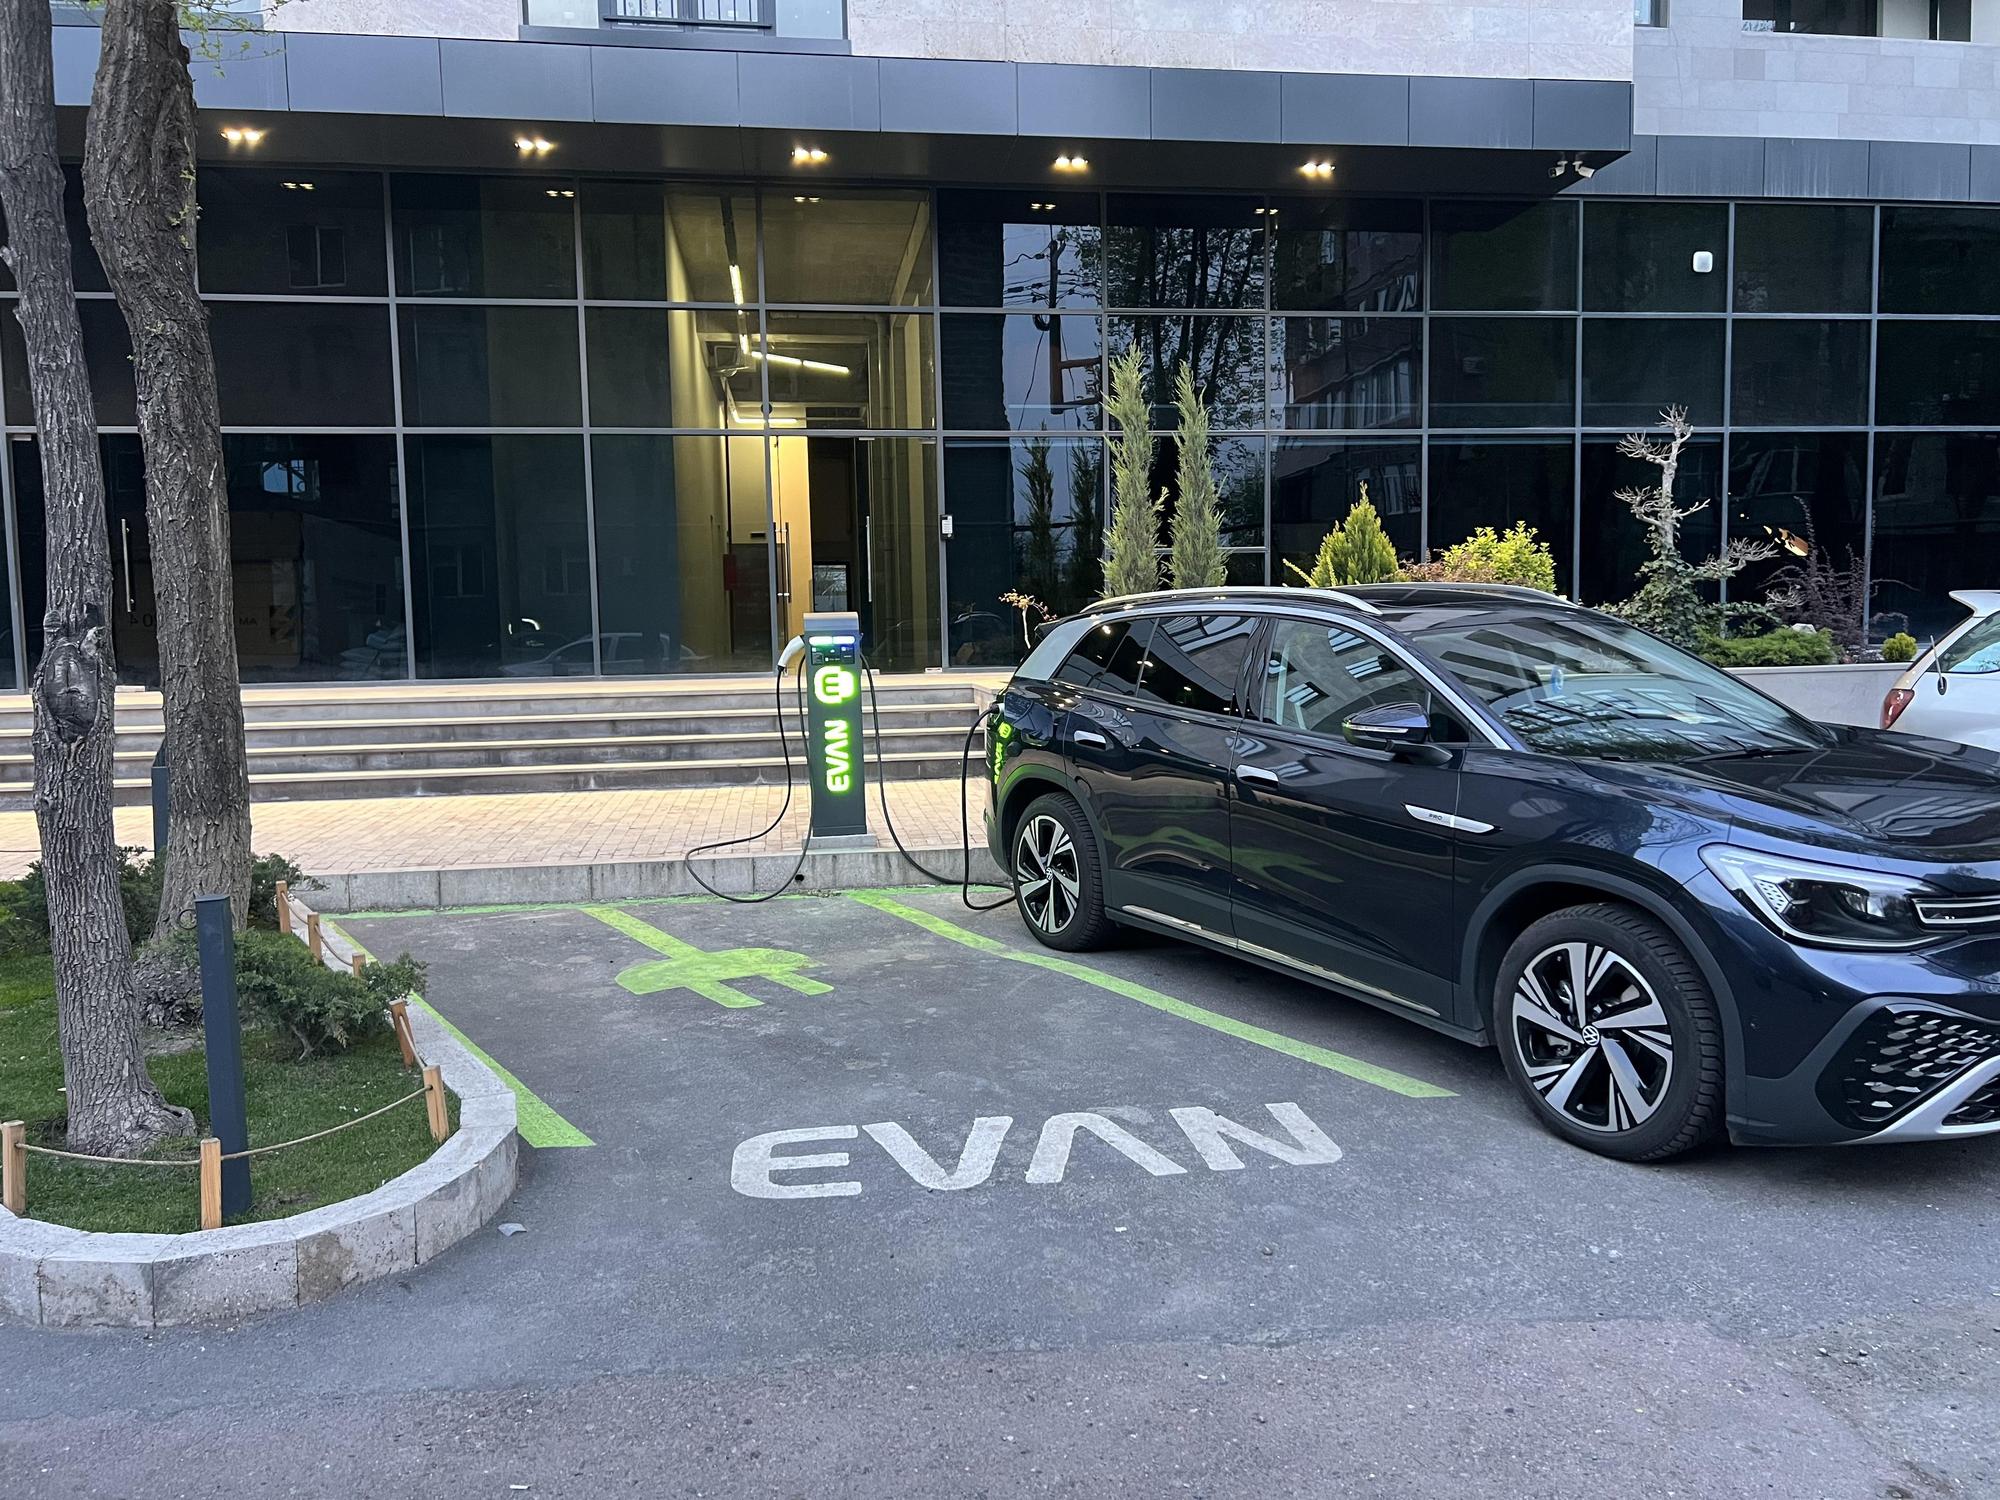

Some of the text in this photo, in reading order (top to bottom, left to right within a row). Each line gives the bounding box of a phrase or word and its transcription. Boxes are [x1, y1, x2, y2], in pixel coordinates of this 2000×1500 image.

[824, 719, 850, 792] EVAN
[1428, 813, 1443, 821] PRO
[731, 1102, 1343, 1199] EVAN
